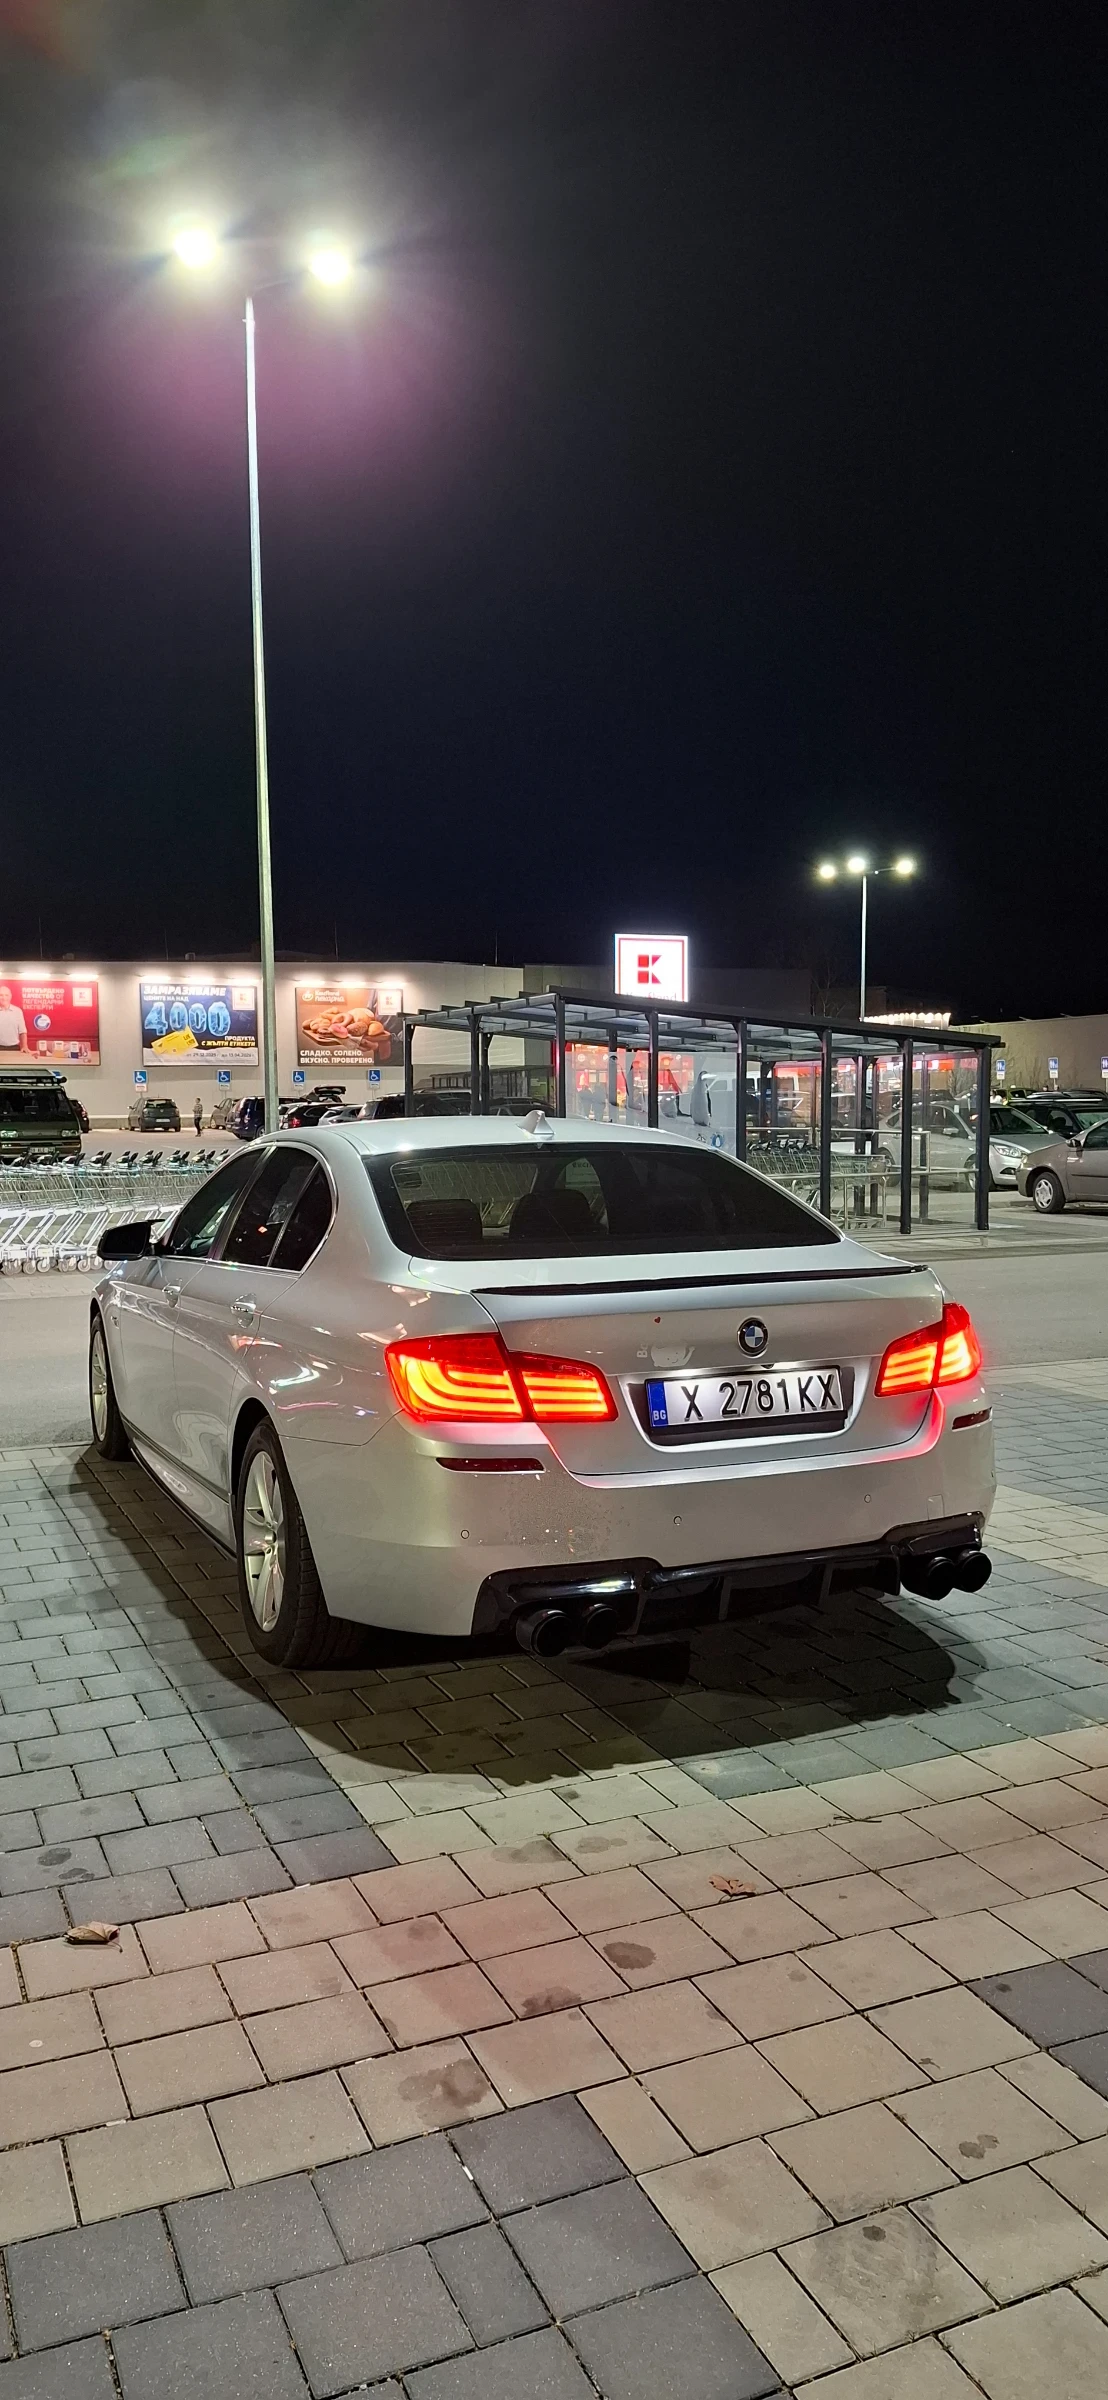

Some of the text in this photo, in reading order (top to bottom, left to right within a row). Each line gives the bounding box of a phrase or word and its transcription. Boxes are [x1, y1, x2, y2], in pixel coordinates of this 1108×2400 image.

[143, 985, 227, 997] ЗАМРАЗЯВАМЕ
[144, 1001, 231, 1036] 4000
[680, 1384, 704, 1422] X
[652, 1410, 667, 1421] BG
